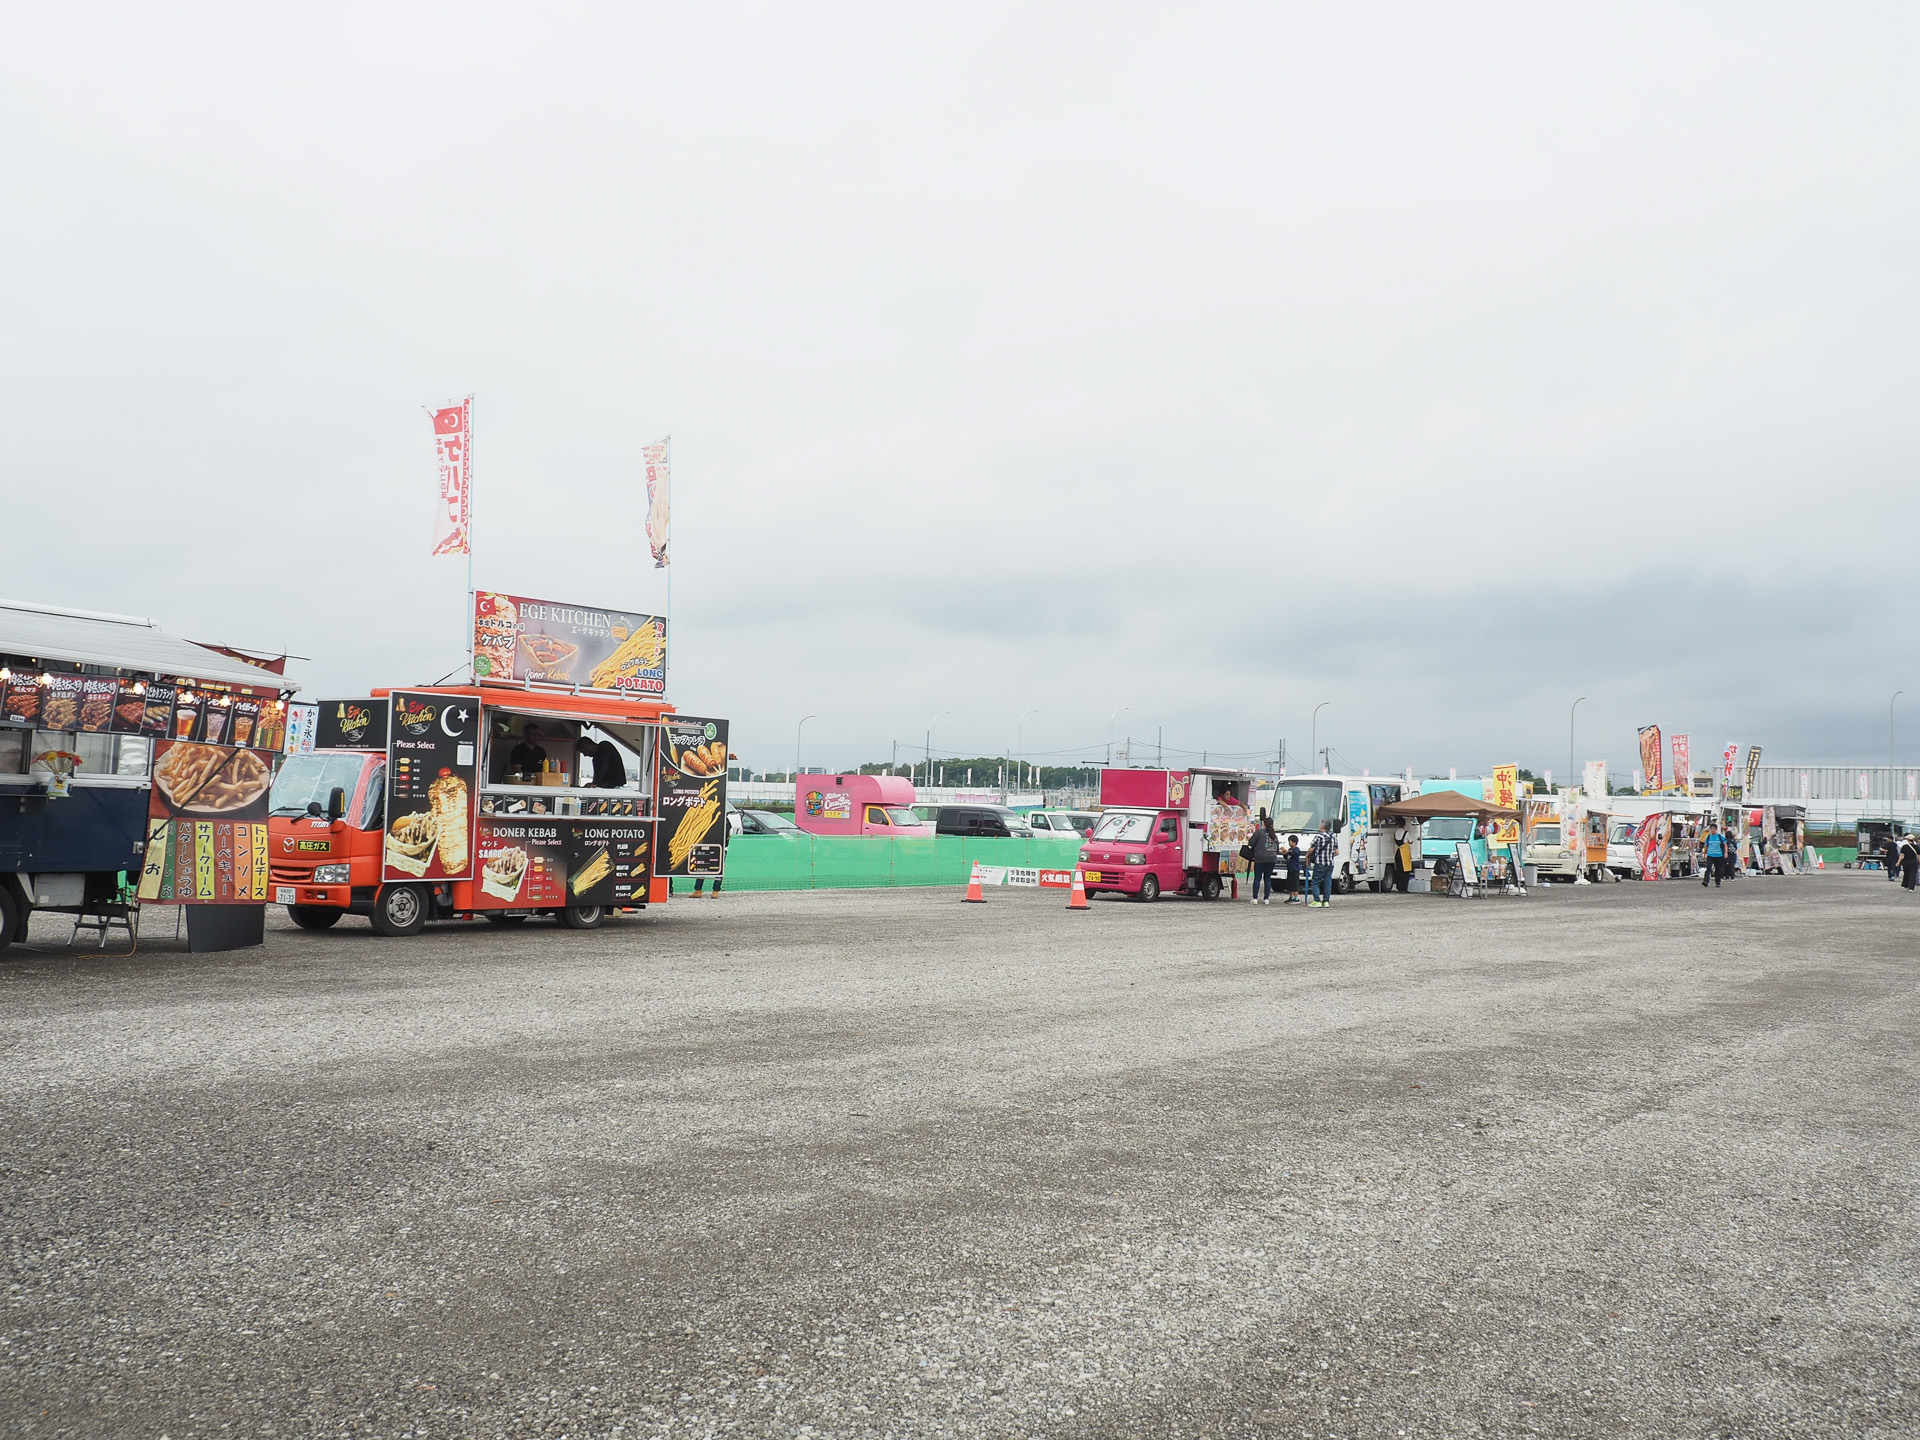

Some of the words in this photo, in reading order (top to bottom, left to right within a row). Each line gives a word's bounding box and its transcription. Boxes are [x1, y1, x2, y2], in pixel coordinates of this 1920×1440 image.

[519, 603, 547, 620] EGE
[551, 607, 611, 628] KITCHEN
[572, 626, 610, 637] エーグキッチン
[481, 632, 515, 649] ケバブ
[621, 657, 649, 670] ロングポテト
[524, 668, 545, 680] Doner
[547, 667, 569, 680] Kebab
[616, 676, 664, 691] POTATO
[304, 709, 315, 738] かき氷
[340, 709, 370, 733] Kitchen
[400, 705, 437, 726] Kitchen
[396, 740, 416, 748] Please
[417, 741, 435, 749] Select
[663, 796, 706, 807] ロングポテト
[493, 827, 526, 838] DONER
[528, 827, 557, 838] KEBAB
[585, 828, 609, 839] LONG
[611, 828, 645, 839] POTATO
[145, 828, 164, 876] しお
[299, 841, 327, 850] 高圧ガス
[179, 822, 193, 897] バターしょうゆ
[198, 824, 212, 896] サワークリーム
[217, 823, 232, 895] バーベキュー
[237, 826, 248, 896] コンソメ
[1041, 873, 1070, 883] 火気厳禁
